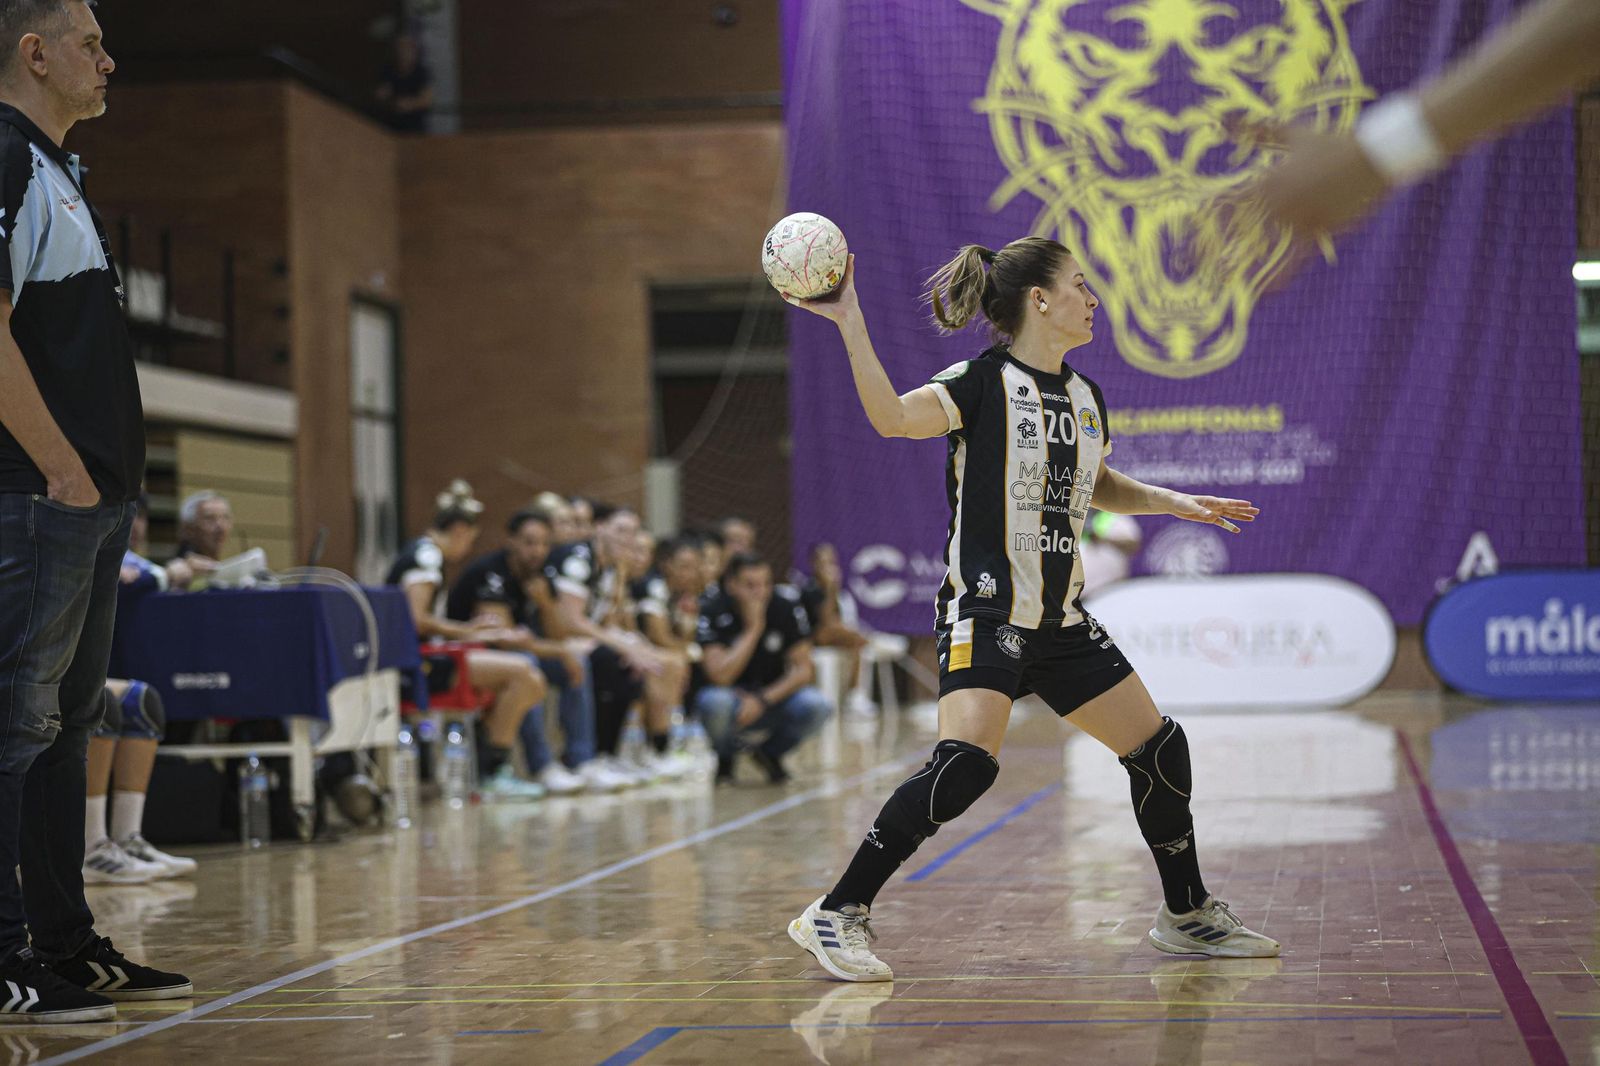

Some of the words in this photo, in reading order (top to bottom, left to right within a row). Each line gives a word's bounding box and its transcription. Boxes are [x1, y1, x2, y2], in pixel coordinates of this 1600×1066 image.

[1010, 397, 1040, 408] Fundación
[1015, 404, 1037, 414] Unicaja
[1044, 409, 1077, 446] 20
[1018, 459, 1093, 489] MÁLAGA
[1017, 503, 1028, 512] LA
